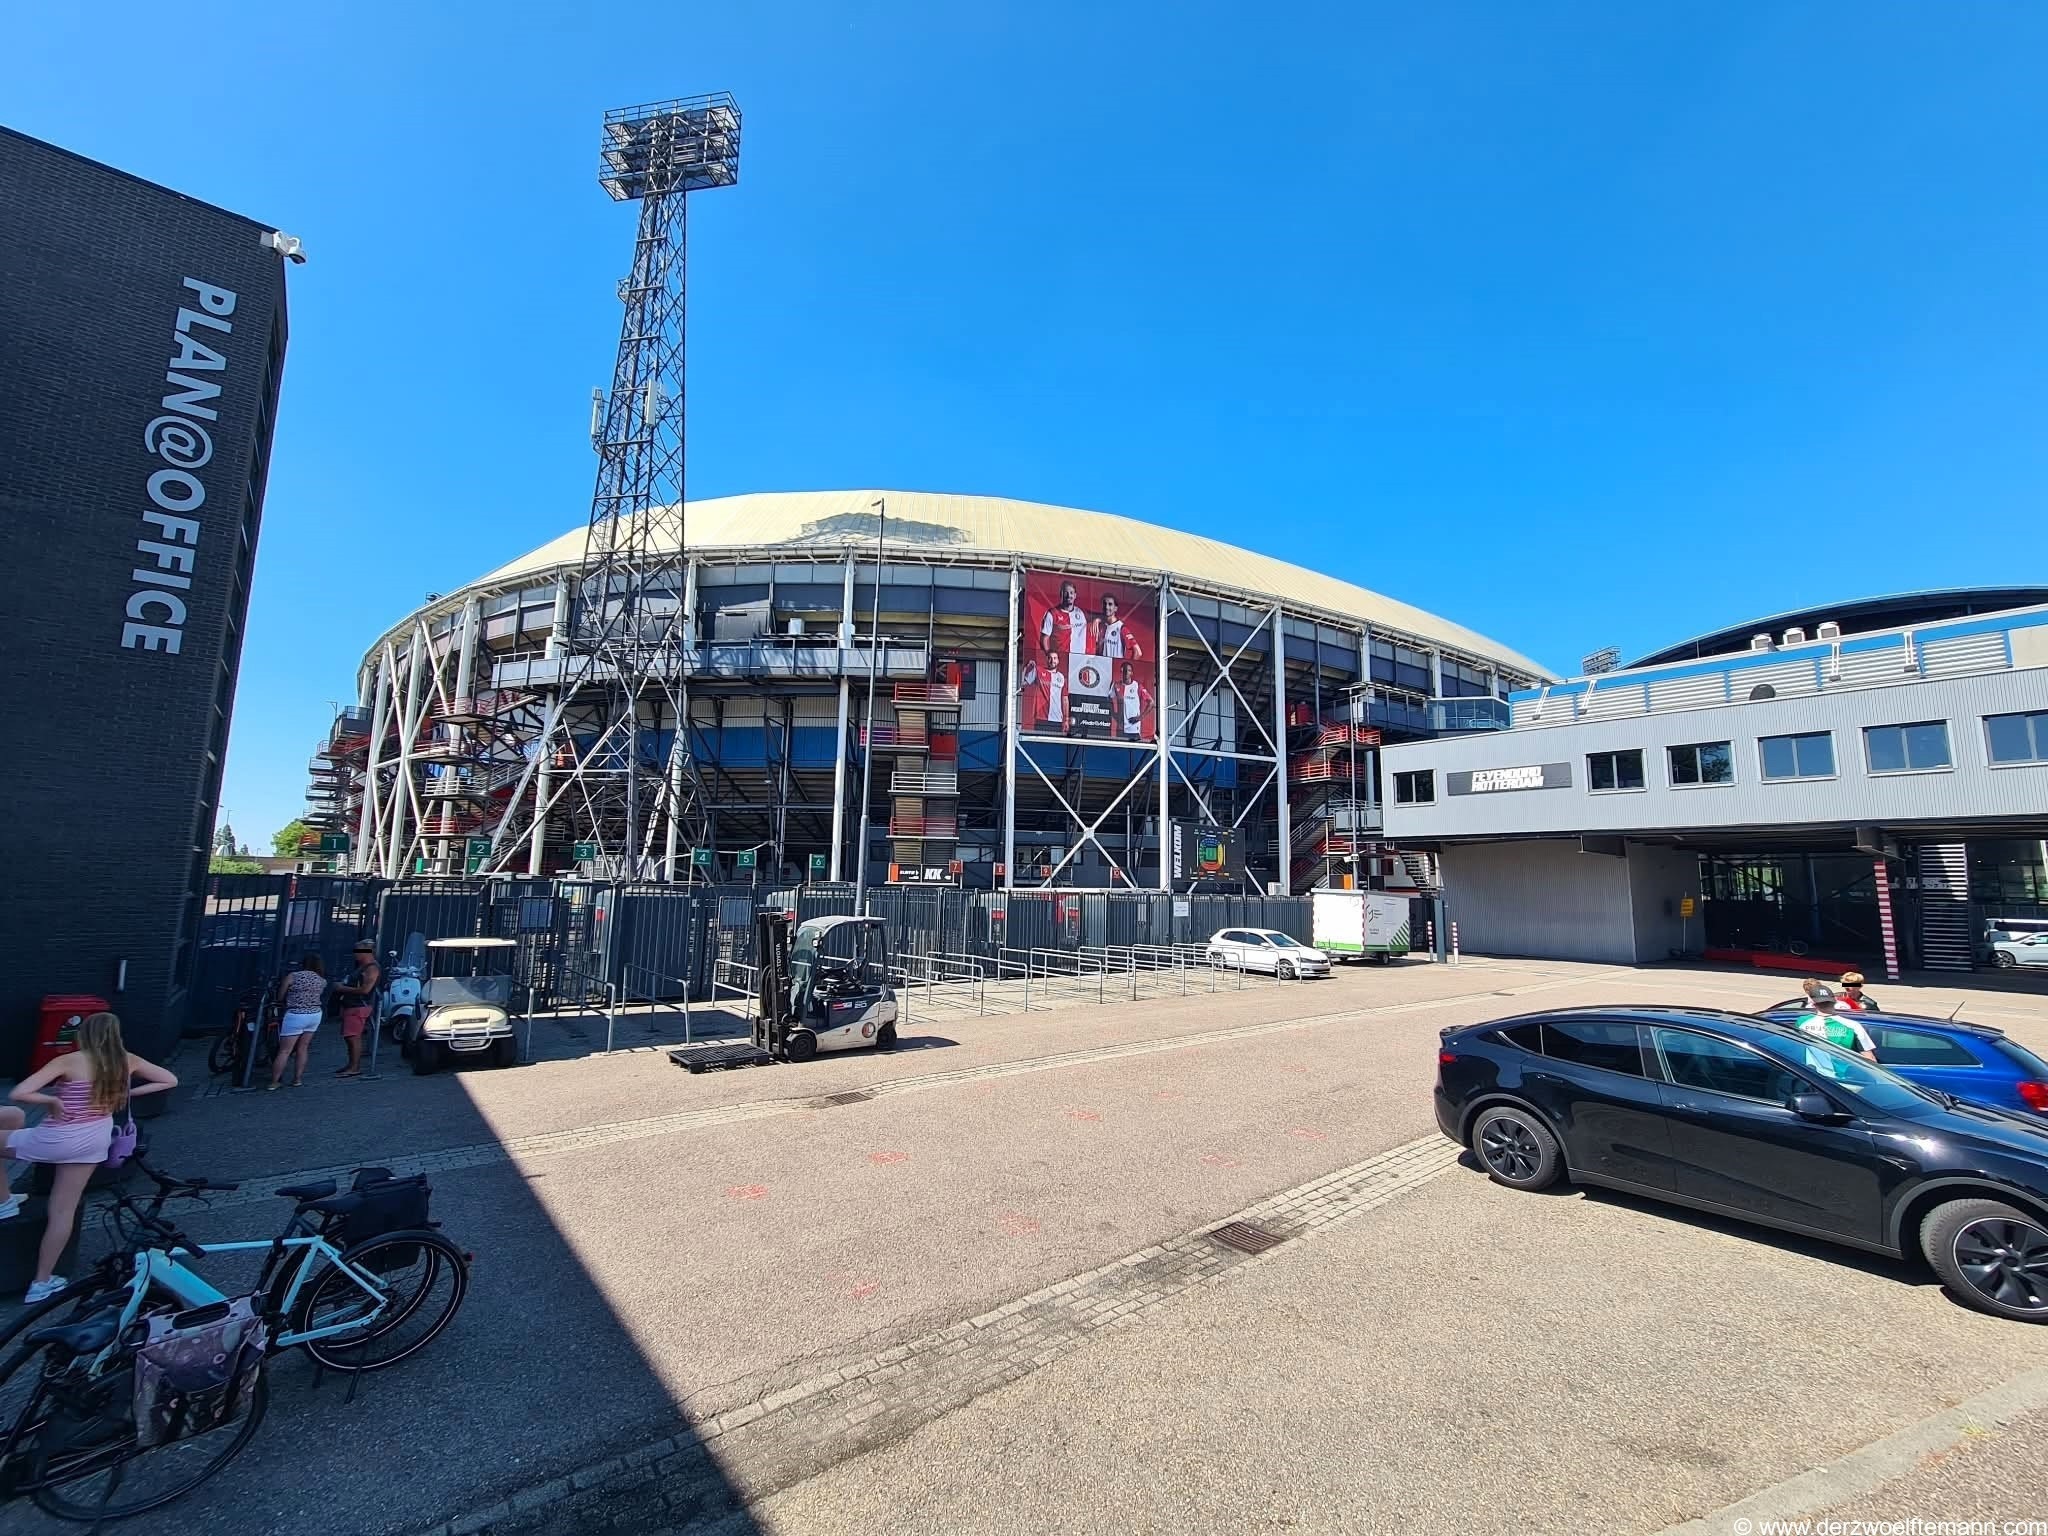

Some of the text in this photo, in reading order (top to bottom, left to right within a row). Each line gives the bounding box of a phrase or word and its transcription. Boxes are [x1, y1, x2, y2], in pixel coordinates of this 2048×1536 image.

[120, 276, 238, 655] PLAN@OFFICE
[331, 838, 337, 849] 1
[476, 844, 485, 854] 2
[579, 848, 587, 857] 3
[1173, 824, 1182, 879] WELKOM
[699, 853, 706, 862] 4
[743, 855, 750, 863] 5
[815, 858, 822, 866] 6
[924, 868, 944, 880] KK
